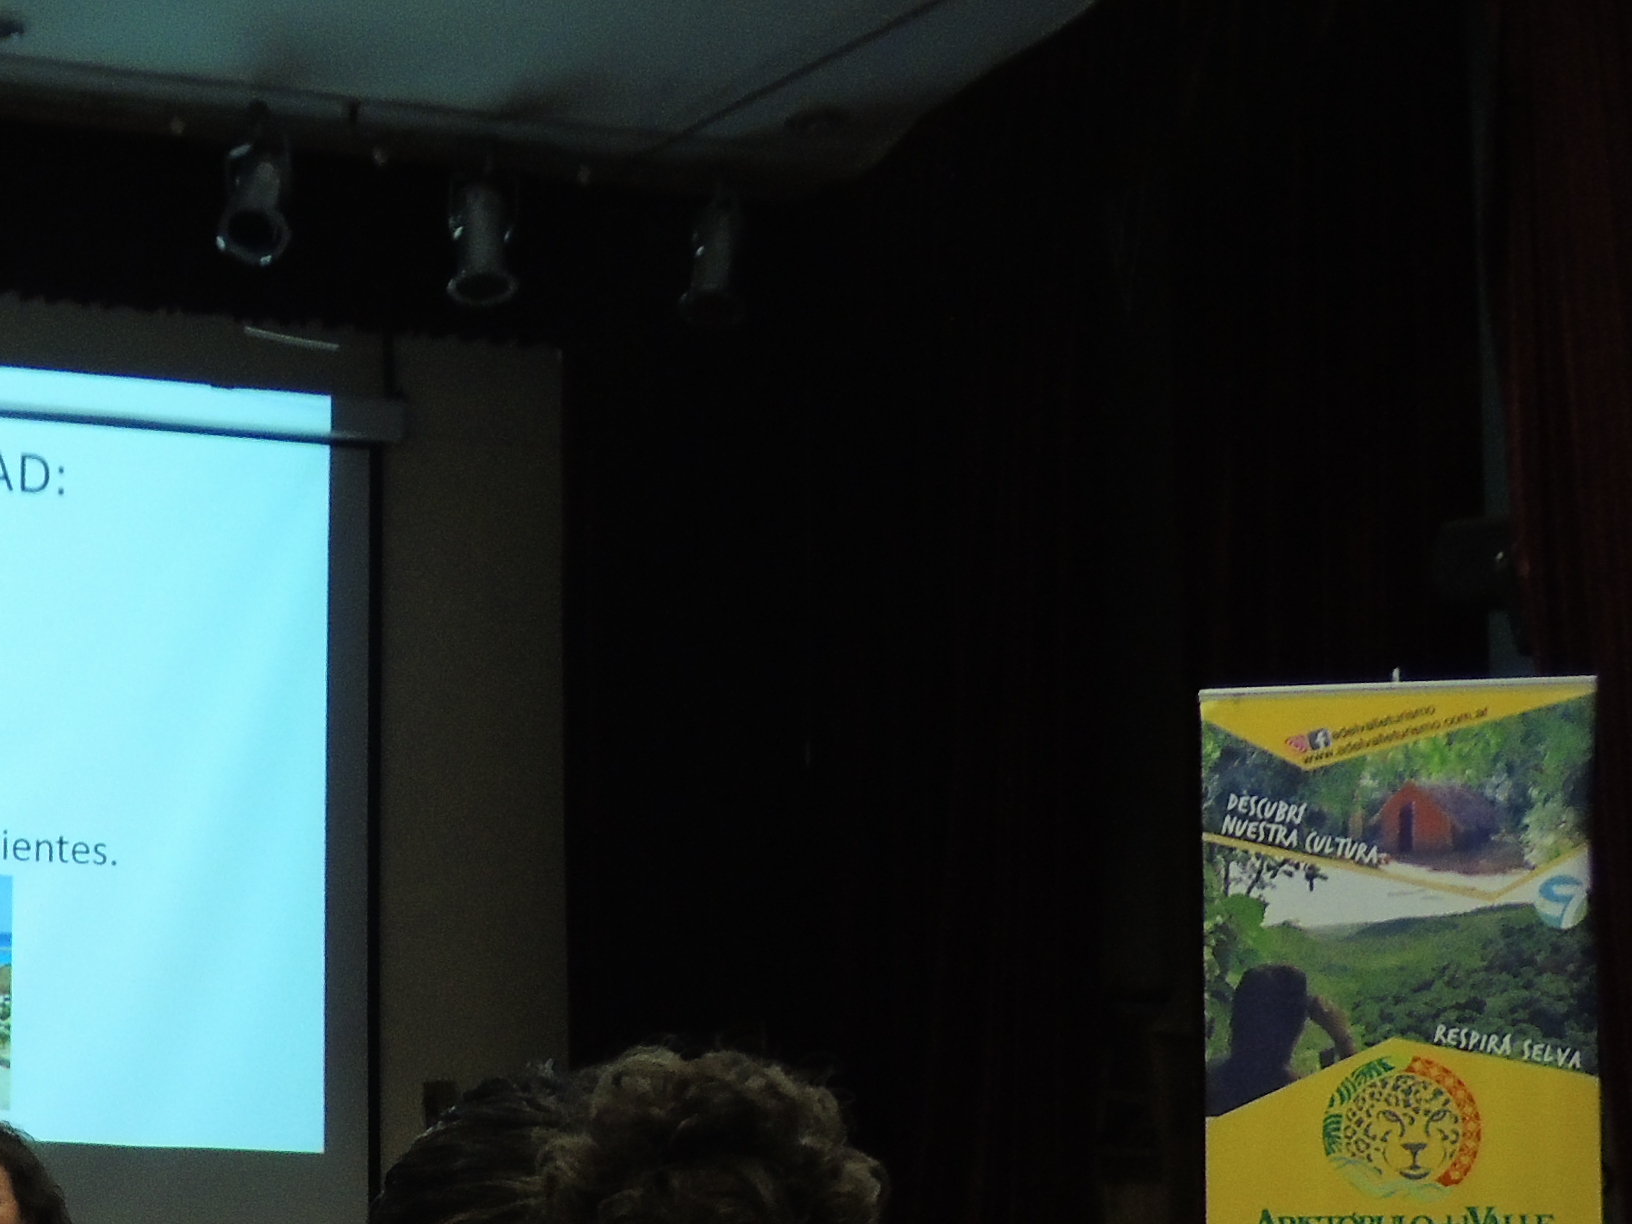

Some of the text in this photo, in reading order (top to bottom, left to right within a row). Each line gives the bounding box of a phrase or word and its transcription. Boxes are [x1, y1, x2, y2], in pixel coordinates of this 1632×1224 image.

[1220, 814, 1379, 865] NUESTRA CULTURA
[1521, 1039, 1582, 1069] SELVA
